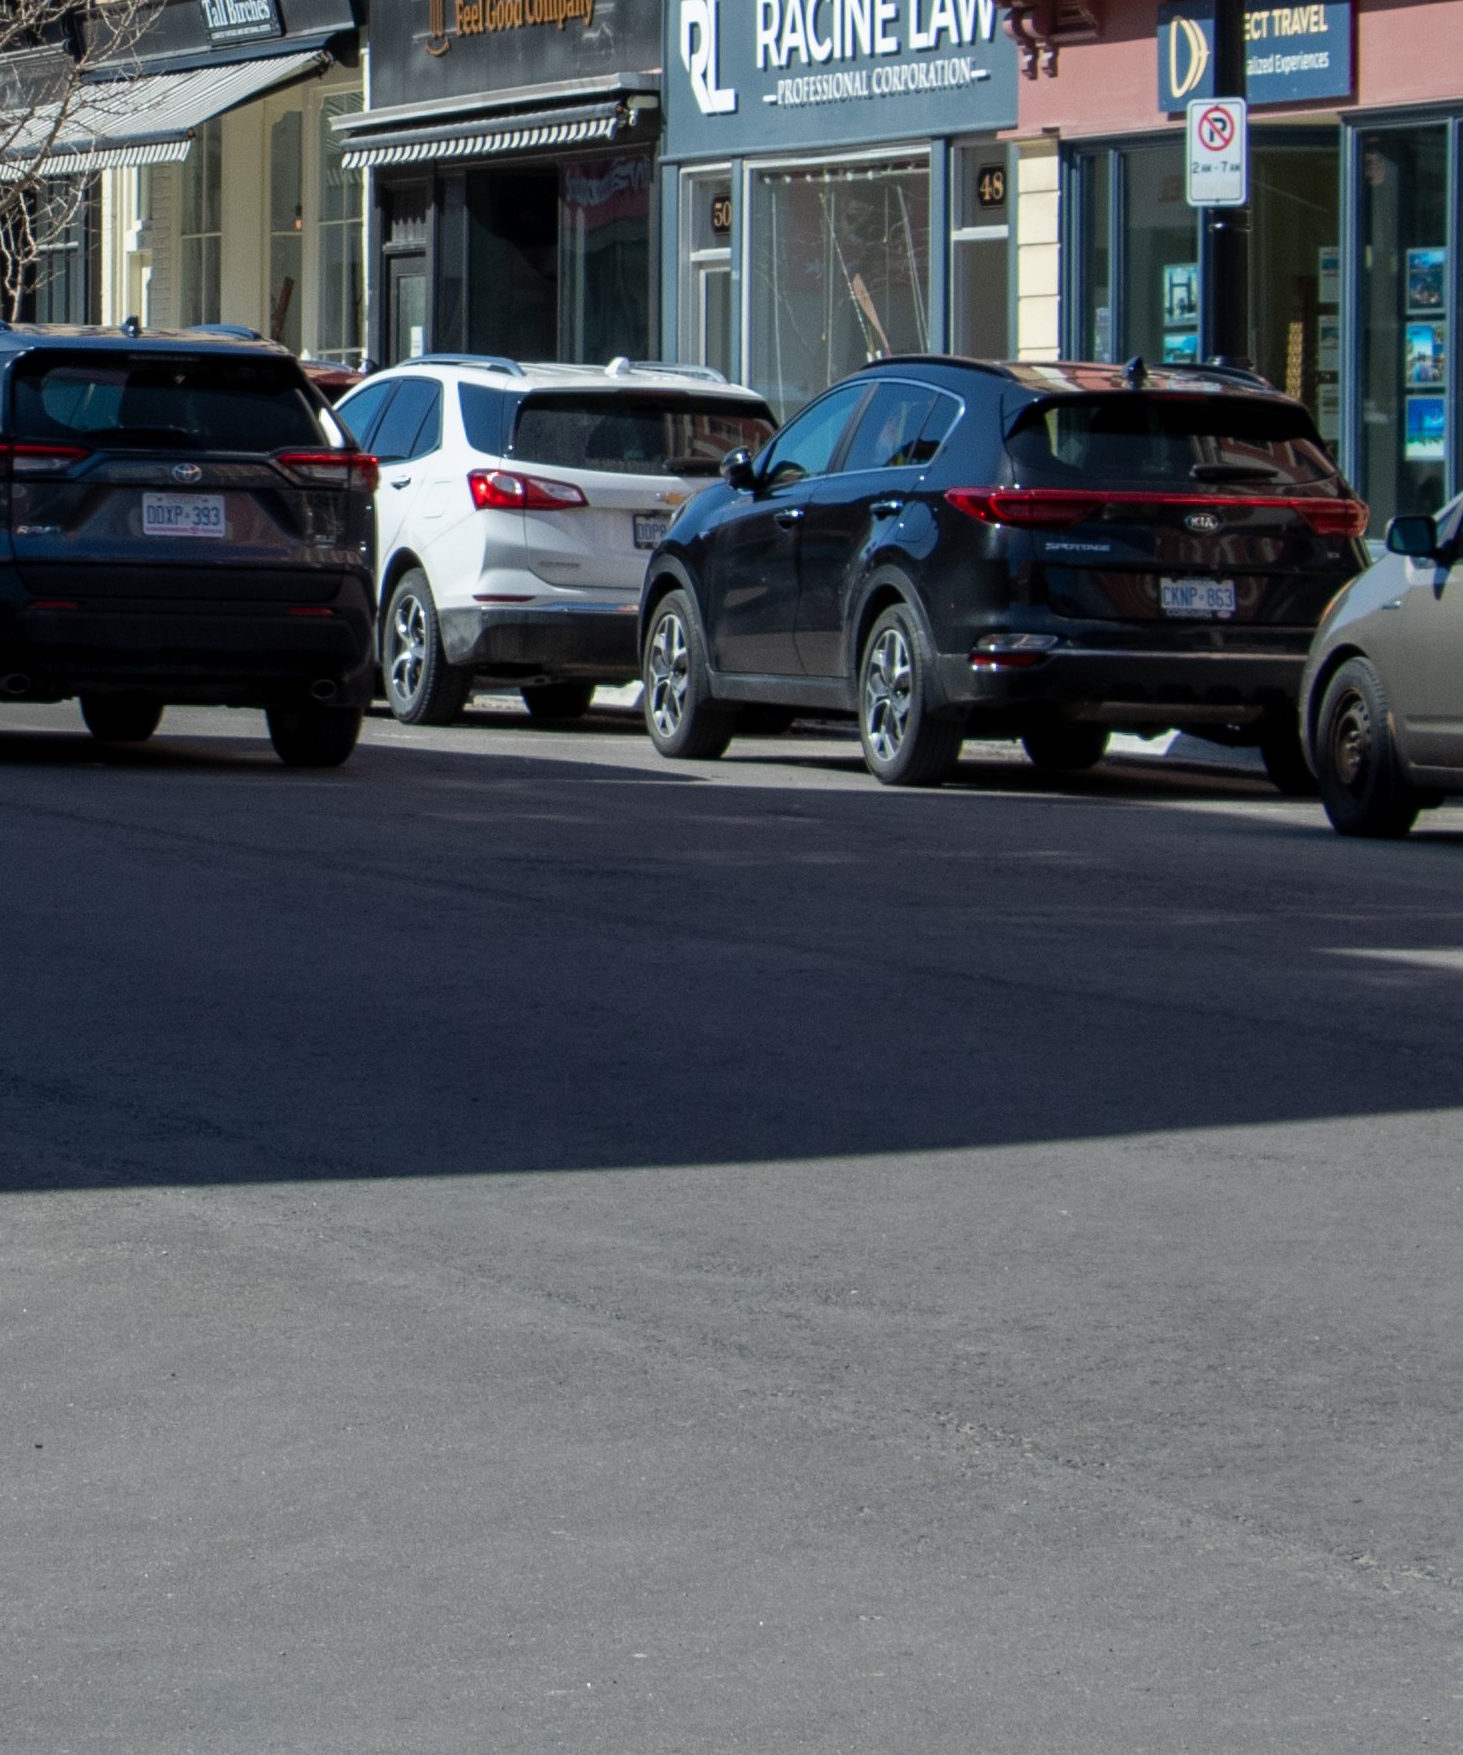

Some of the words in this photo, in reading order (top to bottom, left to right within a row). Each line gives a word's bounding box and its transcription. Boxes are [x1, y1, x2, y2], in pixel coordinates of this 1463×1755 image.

[1271, 4, 1329, 37] TRAVEL
[1275, 50, 1330, 75] Experiences
[777, 66, 869, 106] PROFESSIONAL
[872, 57, 972, 95] CORPORATION
[980, 172, 1004, 200] 48
[713, 201, 732, 227] 50
[192, 506, 220, 526] 393
[1191, 516, 1217, 529] KIA
